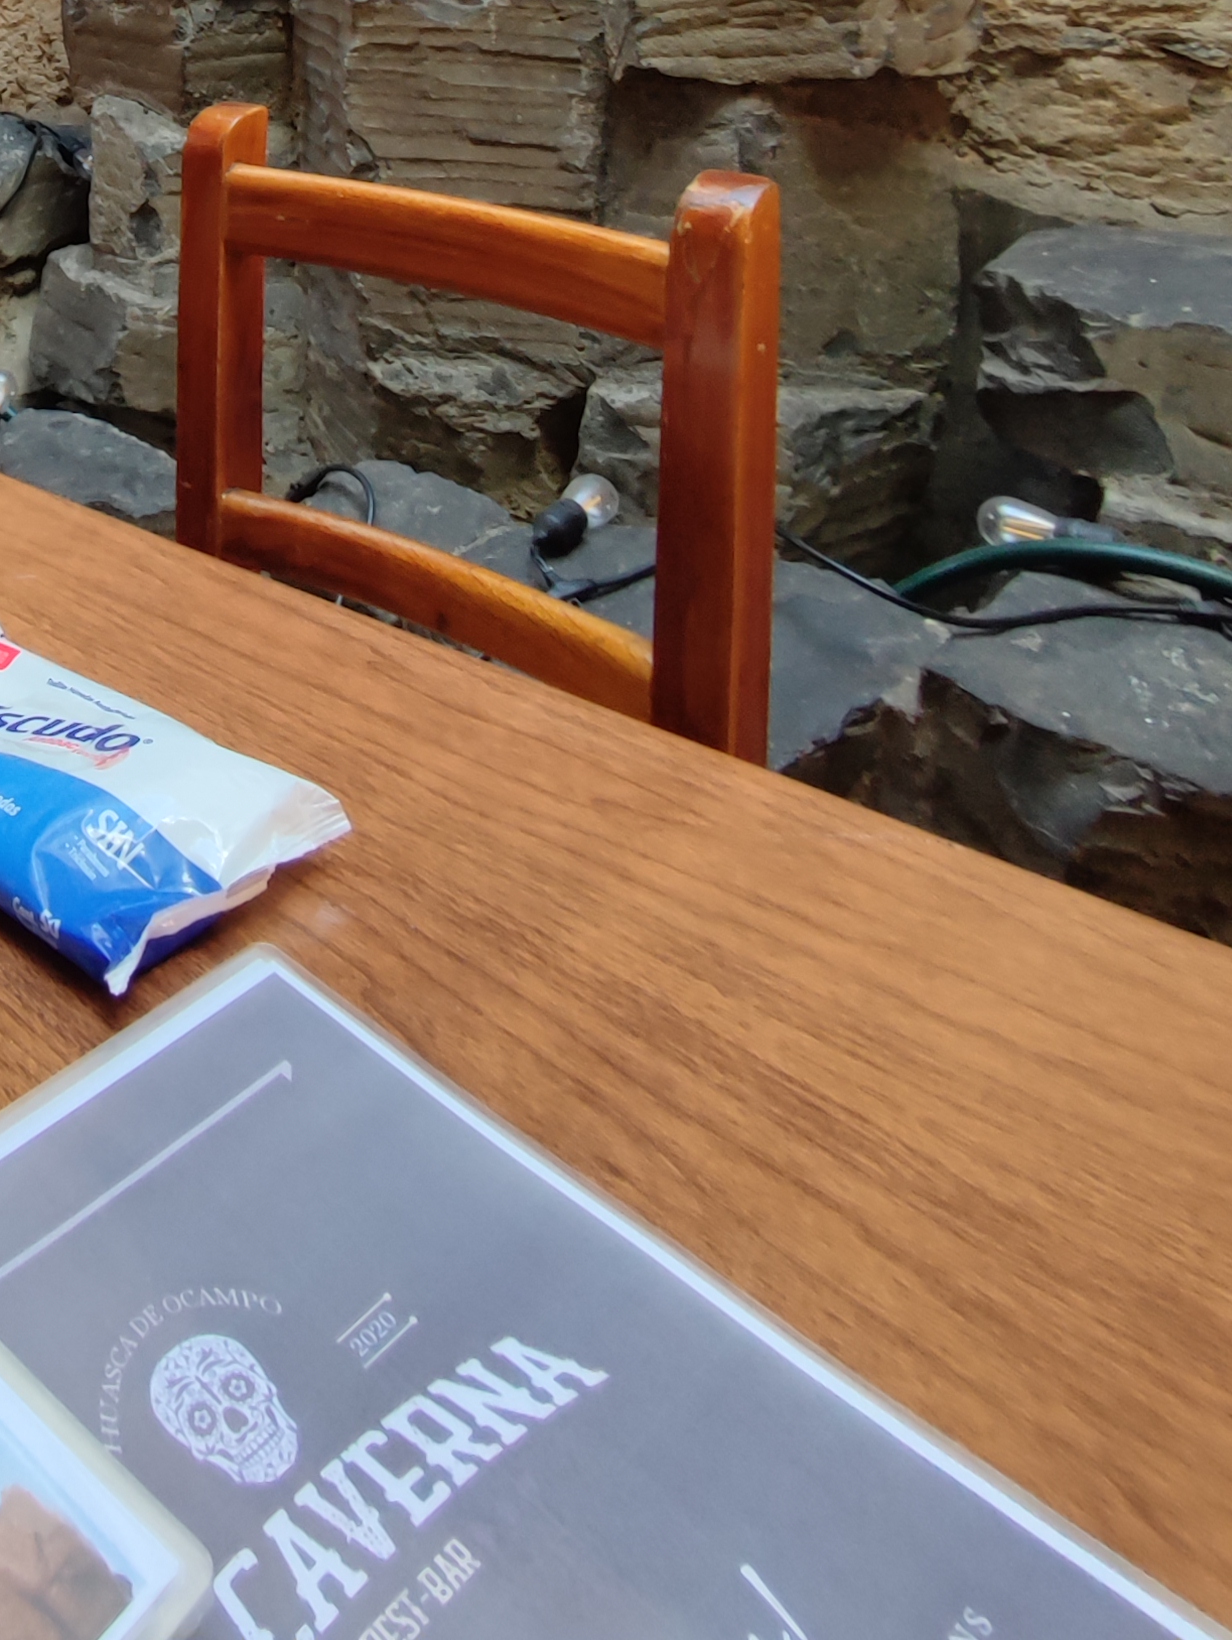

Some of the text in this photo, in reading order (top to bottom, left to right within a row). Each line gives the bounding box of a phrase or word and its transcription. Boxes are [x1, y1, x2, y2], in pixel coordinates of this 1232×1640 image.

[127, 1303, 164, 1338] DE
[159, 1286, 282, 1316] OCAMPO
[348, 1309, 399, 1358] 2020
[213, 1337, 609, 1640] CAVERNA
